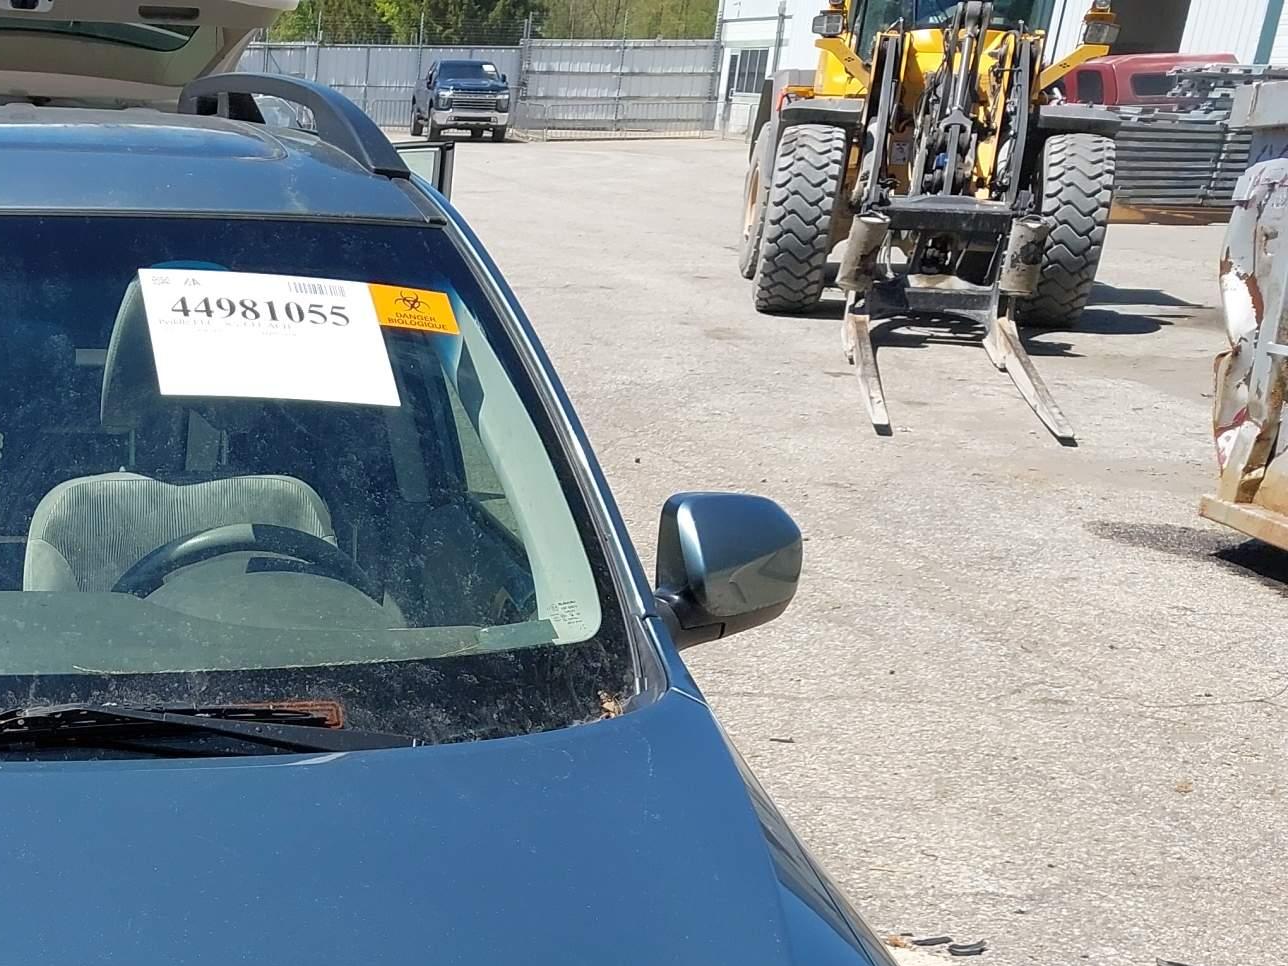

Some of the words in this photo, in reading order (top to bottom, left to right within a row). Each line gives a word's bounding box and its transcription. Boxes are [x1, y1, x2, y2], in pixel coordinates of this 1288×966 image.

[170, 296, 351, 327] 44981055
[395, 311, 437, 323] DANGER
[387, 317, 449, 331] BIOLOGIQUE
